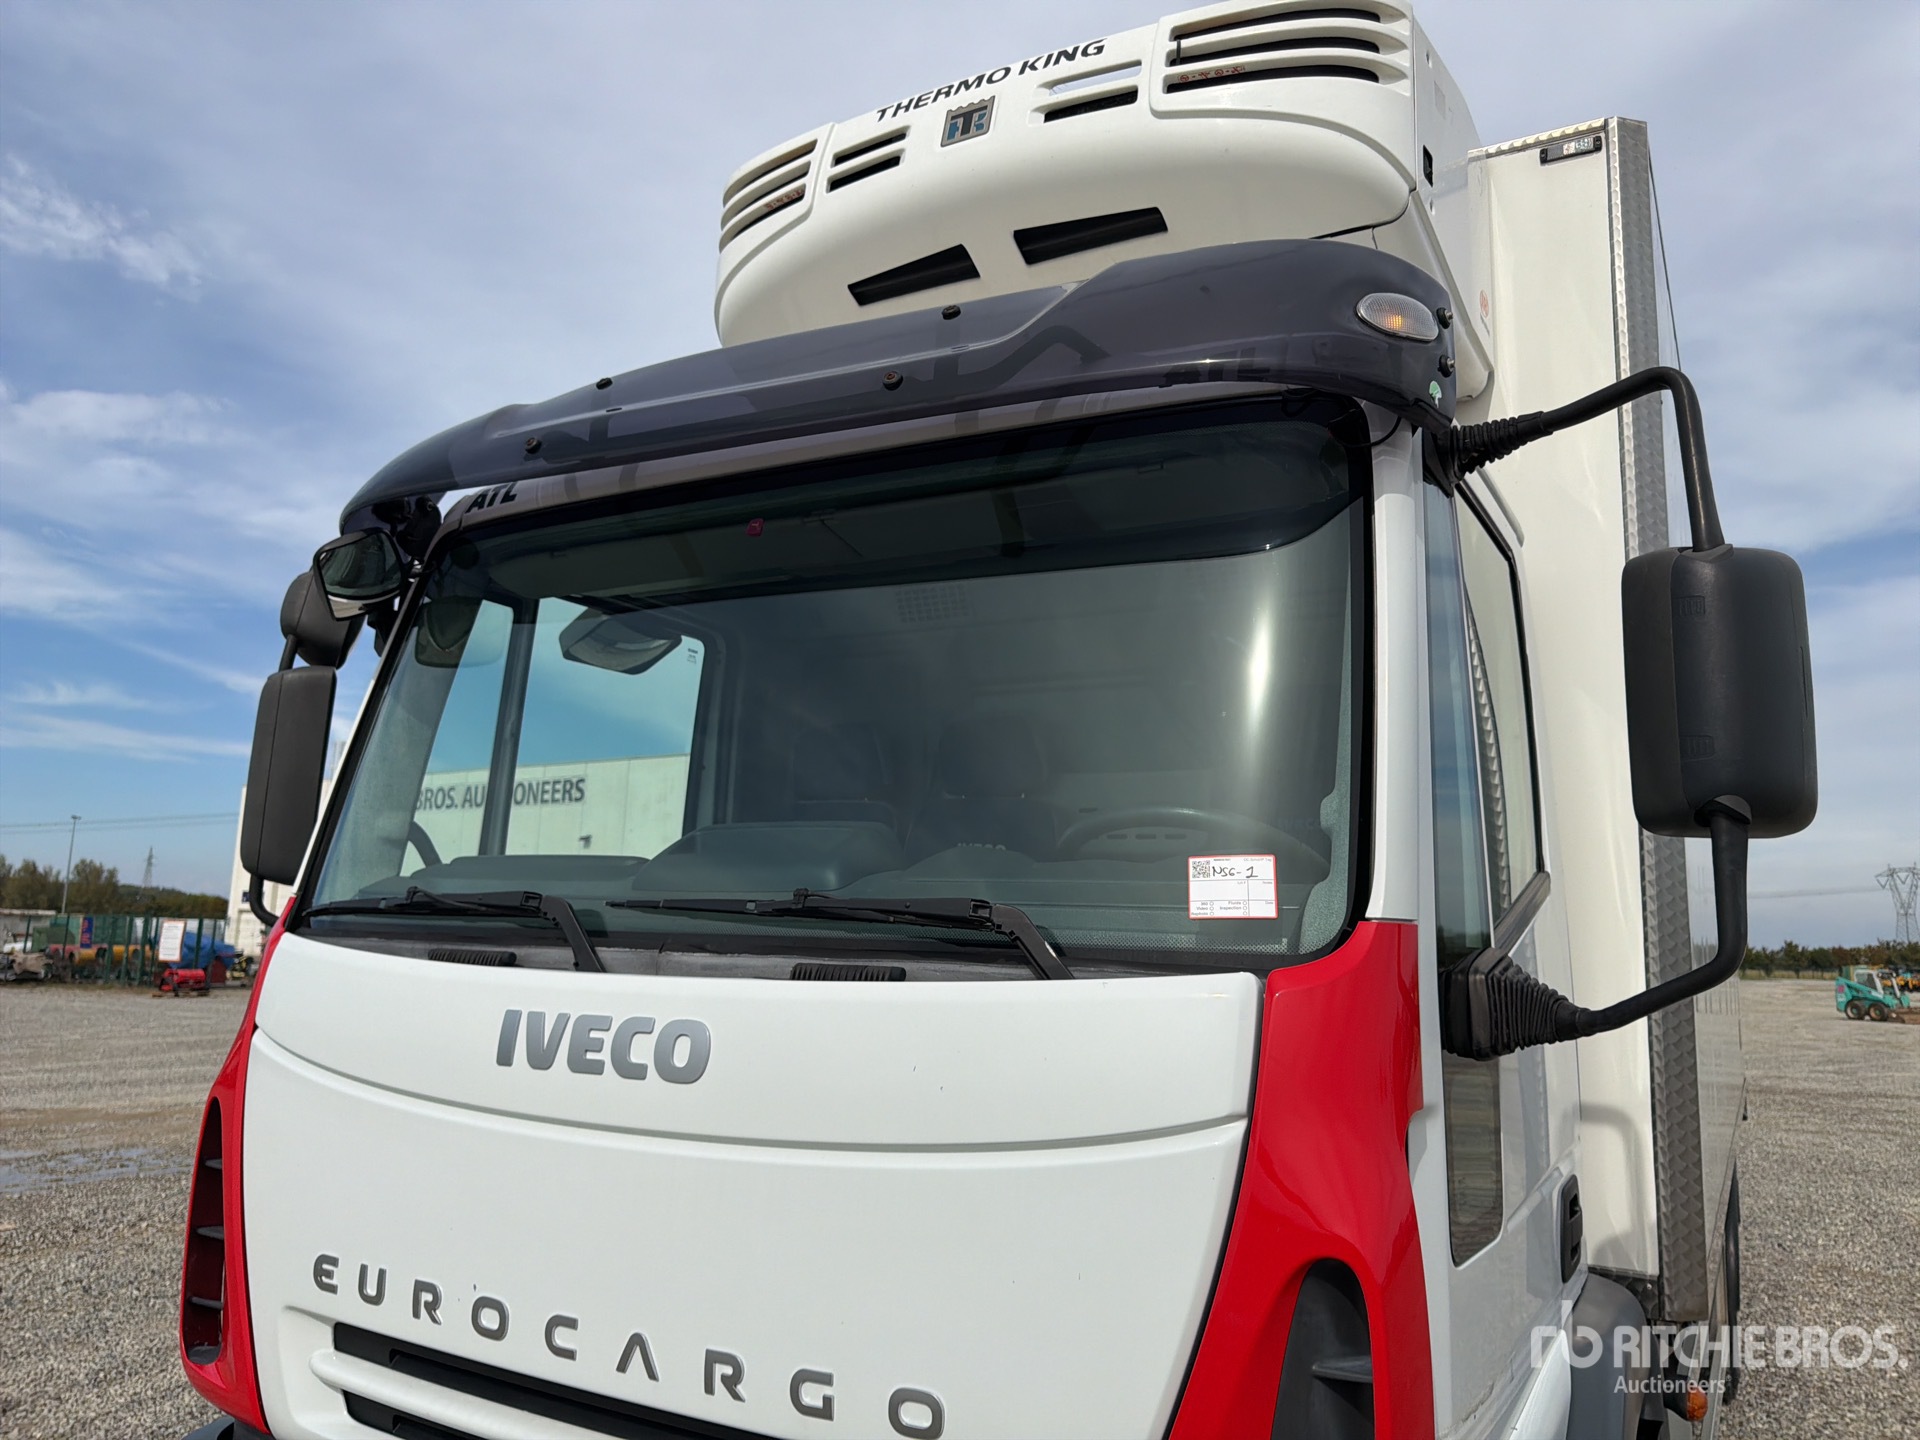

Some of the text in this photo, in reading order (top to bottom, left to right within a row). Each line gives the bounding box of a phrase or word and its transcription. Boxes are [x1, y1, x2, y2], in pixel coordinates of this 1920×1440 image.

[876, 37, 1108, 122] THERMO KING
[465, 481, 519, 514] ATL
[461, 779, 585, 809] AUONEERS
[496, 1008, 711, 1085] IVECO
[313, 1253, 946, 1440] EUROCARGO
